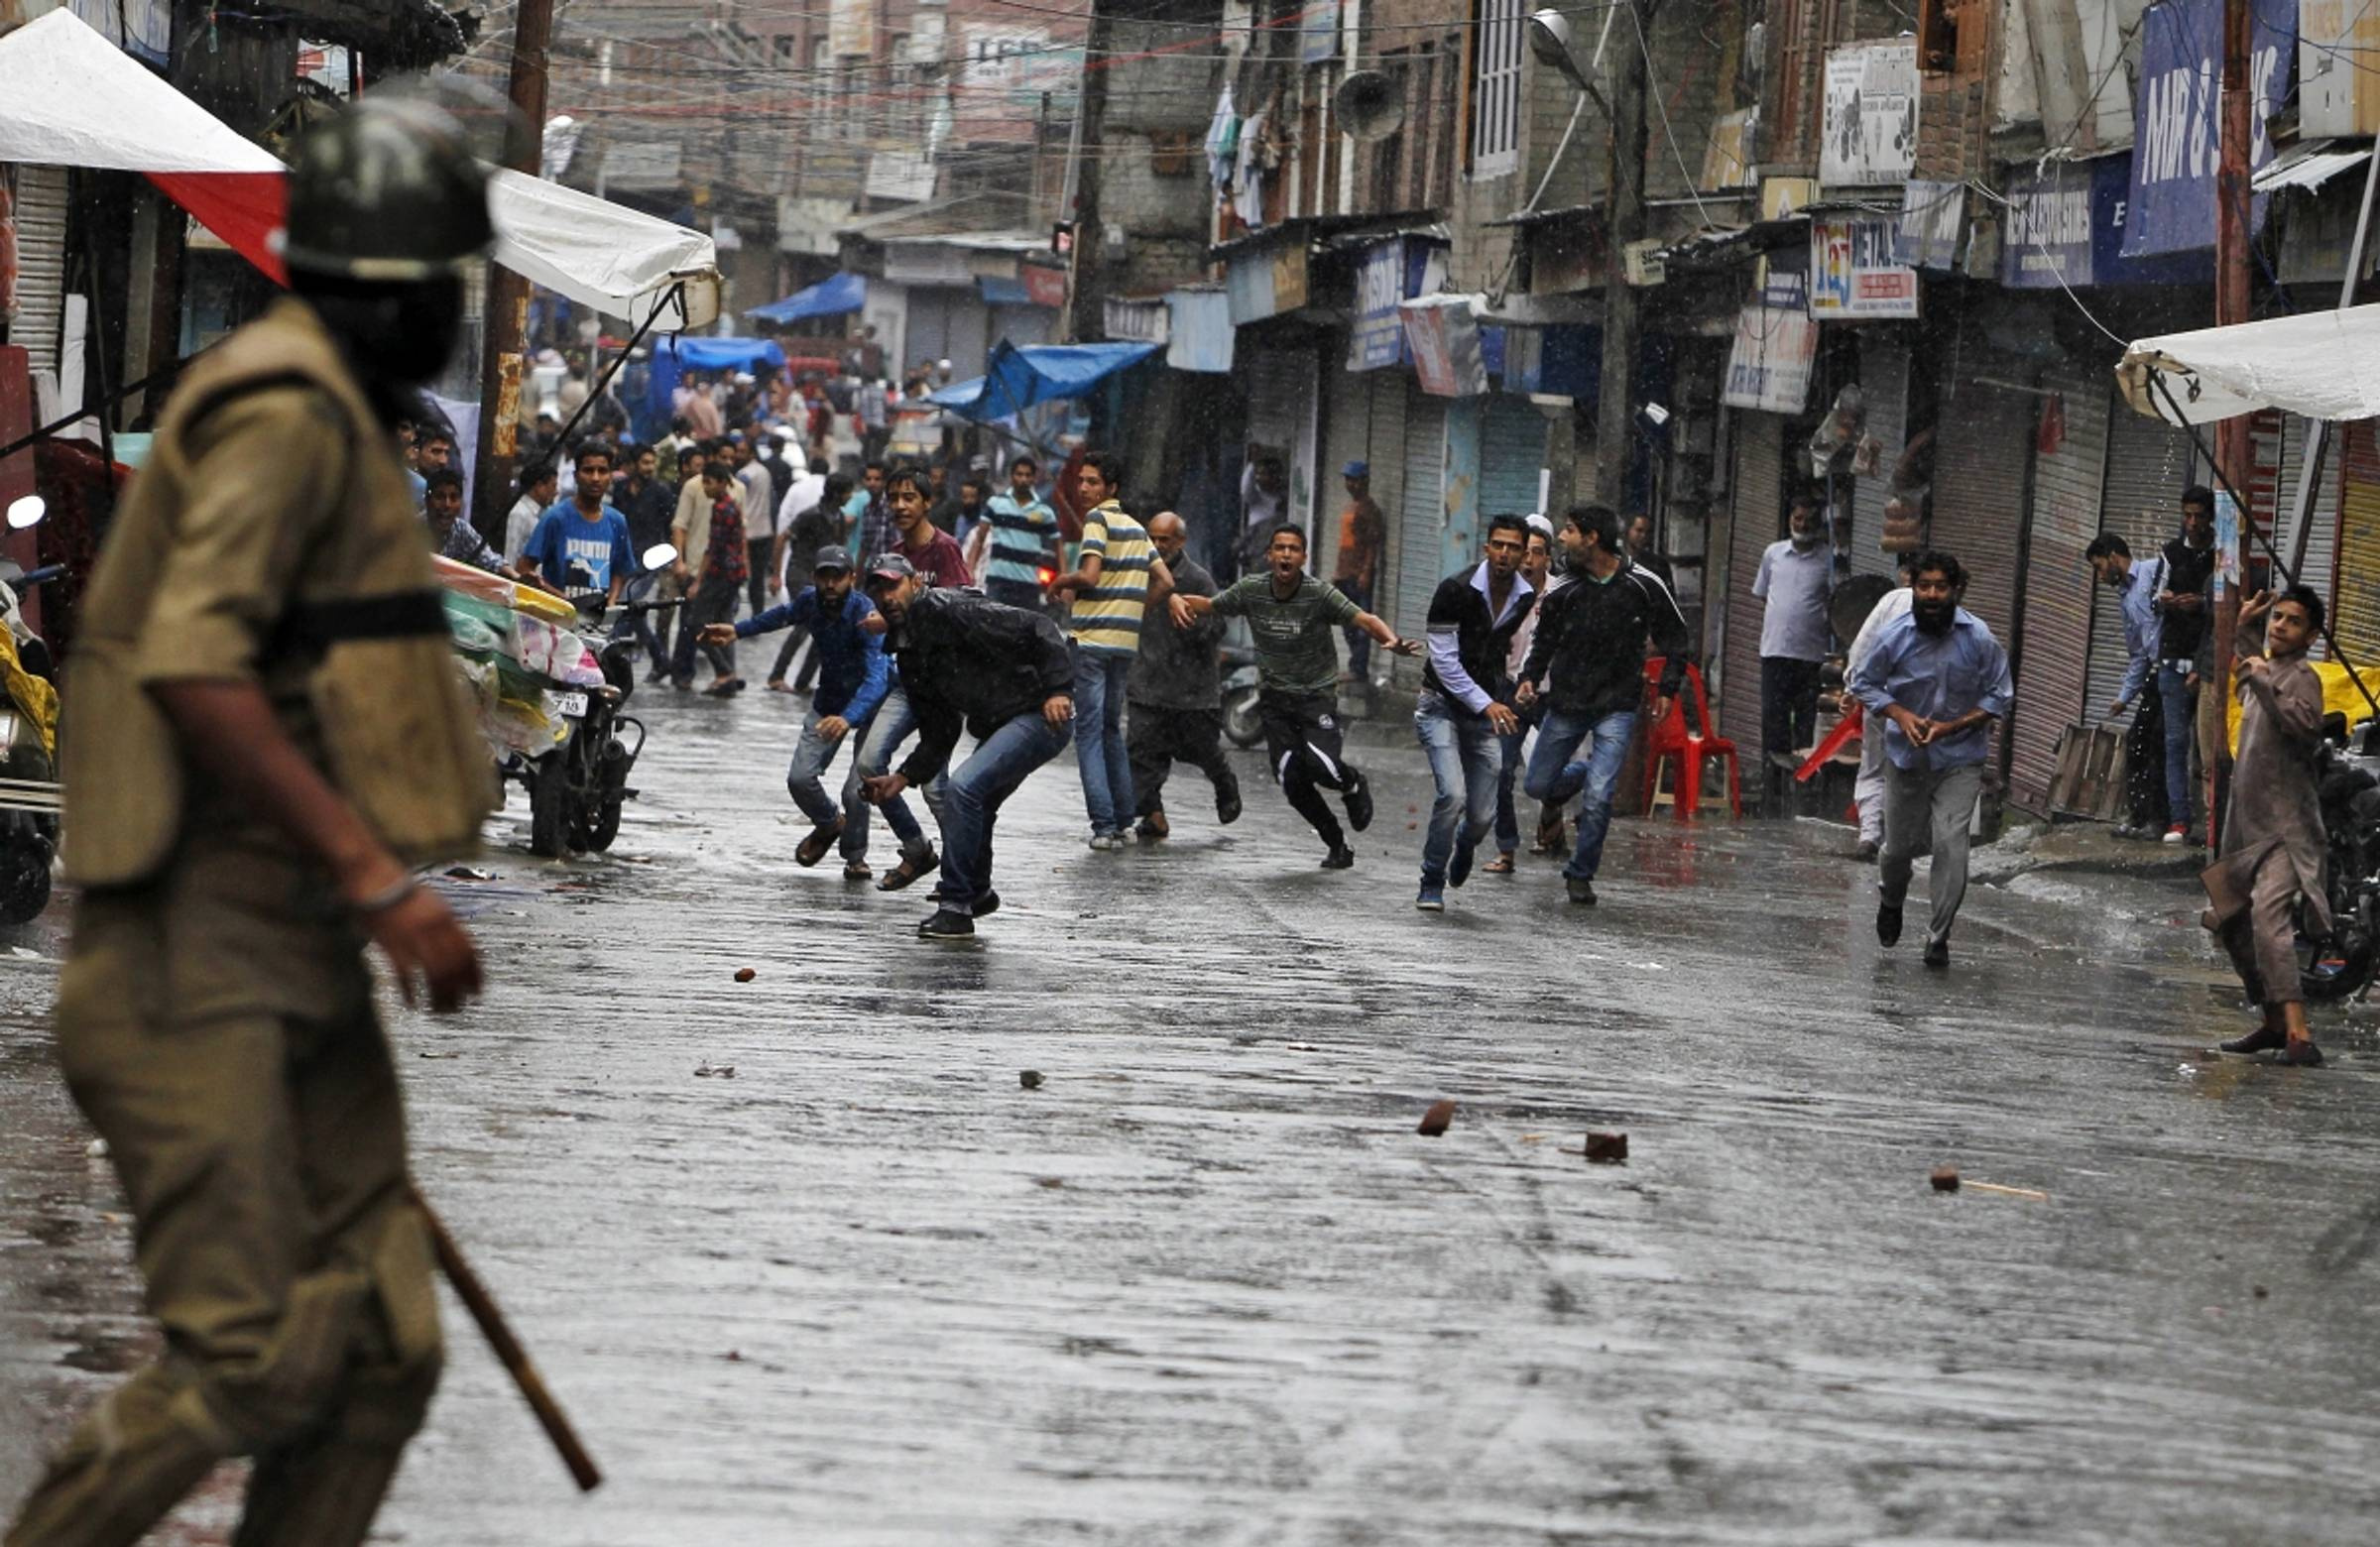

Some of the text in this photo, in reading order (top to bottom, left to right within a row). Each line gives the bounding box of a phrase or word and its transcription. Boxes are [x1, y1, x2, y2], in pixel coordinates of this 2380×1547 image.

[2141, 66, 2192, 186] MIR
[2190, 57, 2211, 179] &
[566, 538, 612, 560] PUMA
